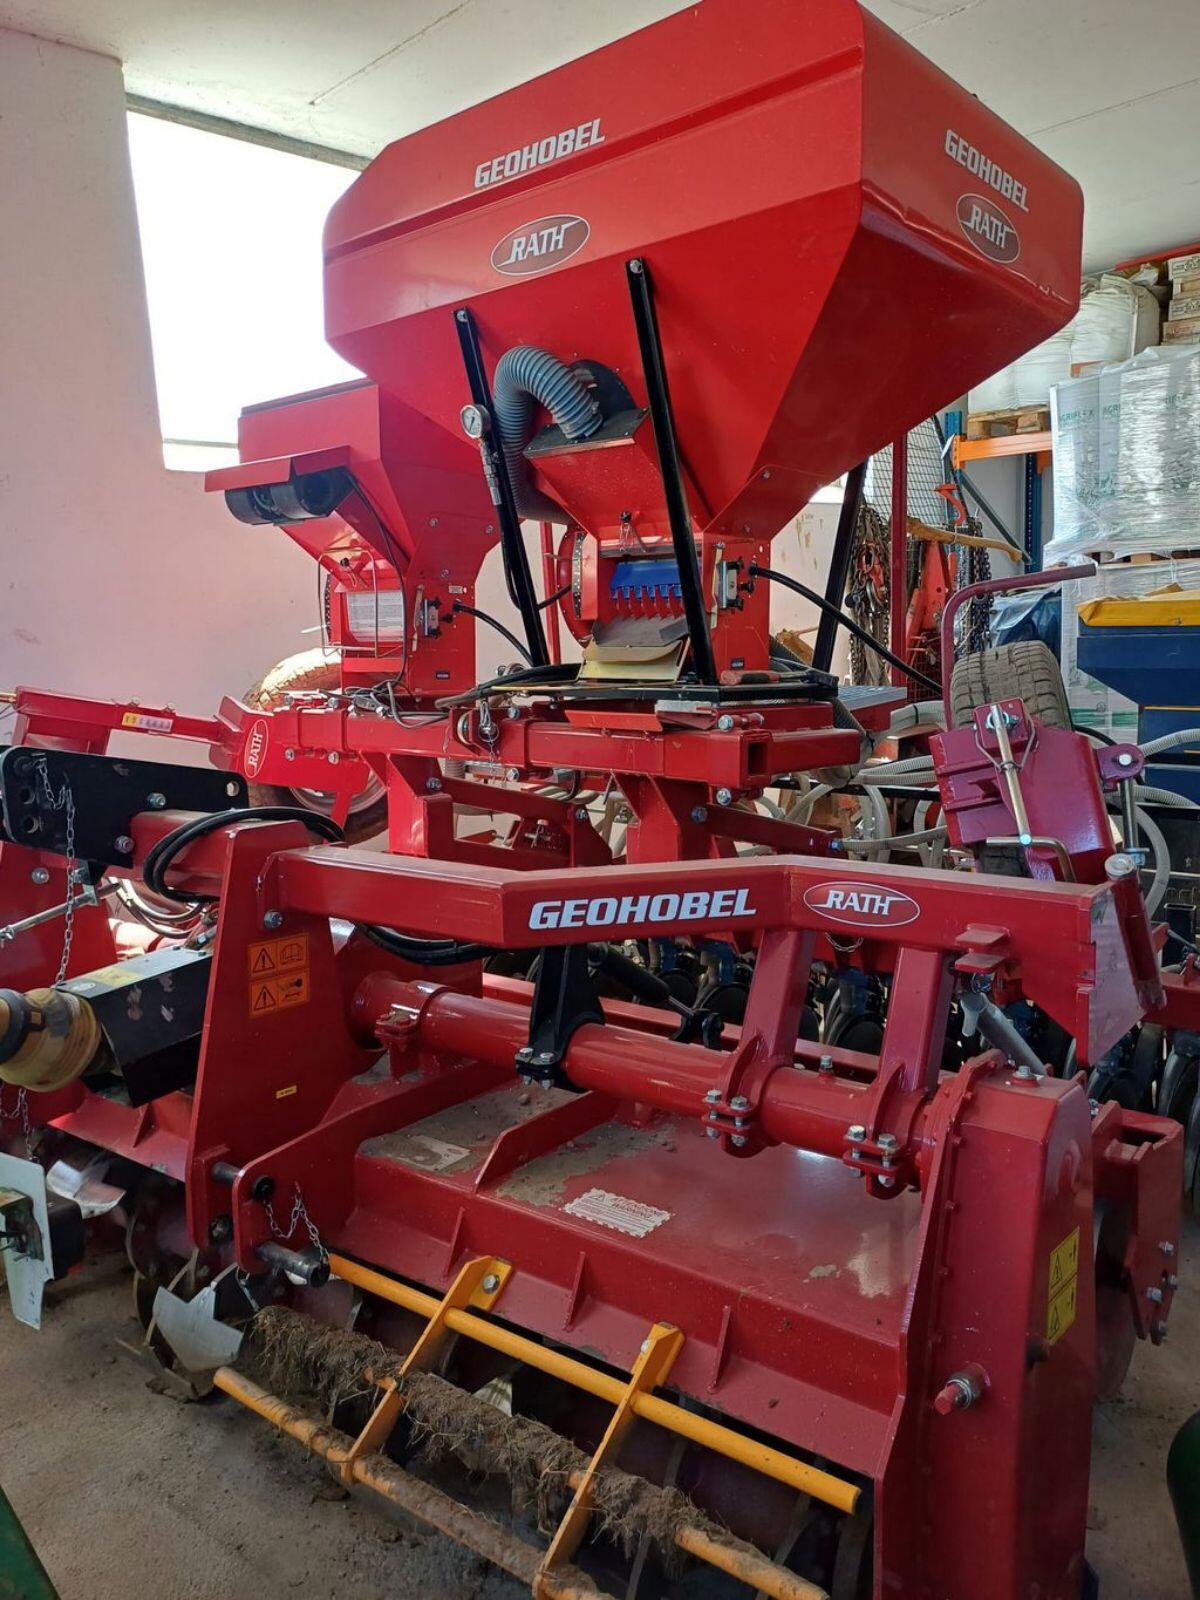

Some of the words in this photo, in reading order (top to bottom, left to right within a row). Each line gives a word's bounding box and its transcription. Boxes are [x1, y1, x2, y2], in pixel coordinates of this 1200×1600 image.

[475, 118, 605, 188] GEOHOBEL
[945, 129, 1029, 212] GEOHOBEL
[497, 218, 582, 267] RATH
[960, 204, 1016, 250] RATH
[248, 726, 264, 776] RATH
[528, 888, 757, 930] GEOHOBEL
[812, 889, 908, 916] RATH
